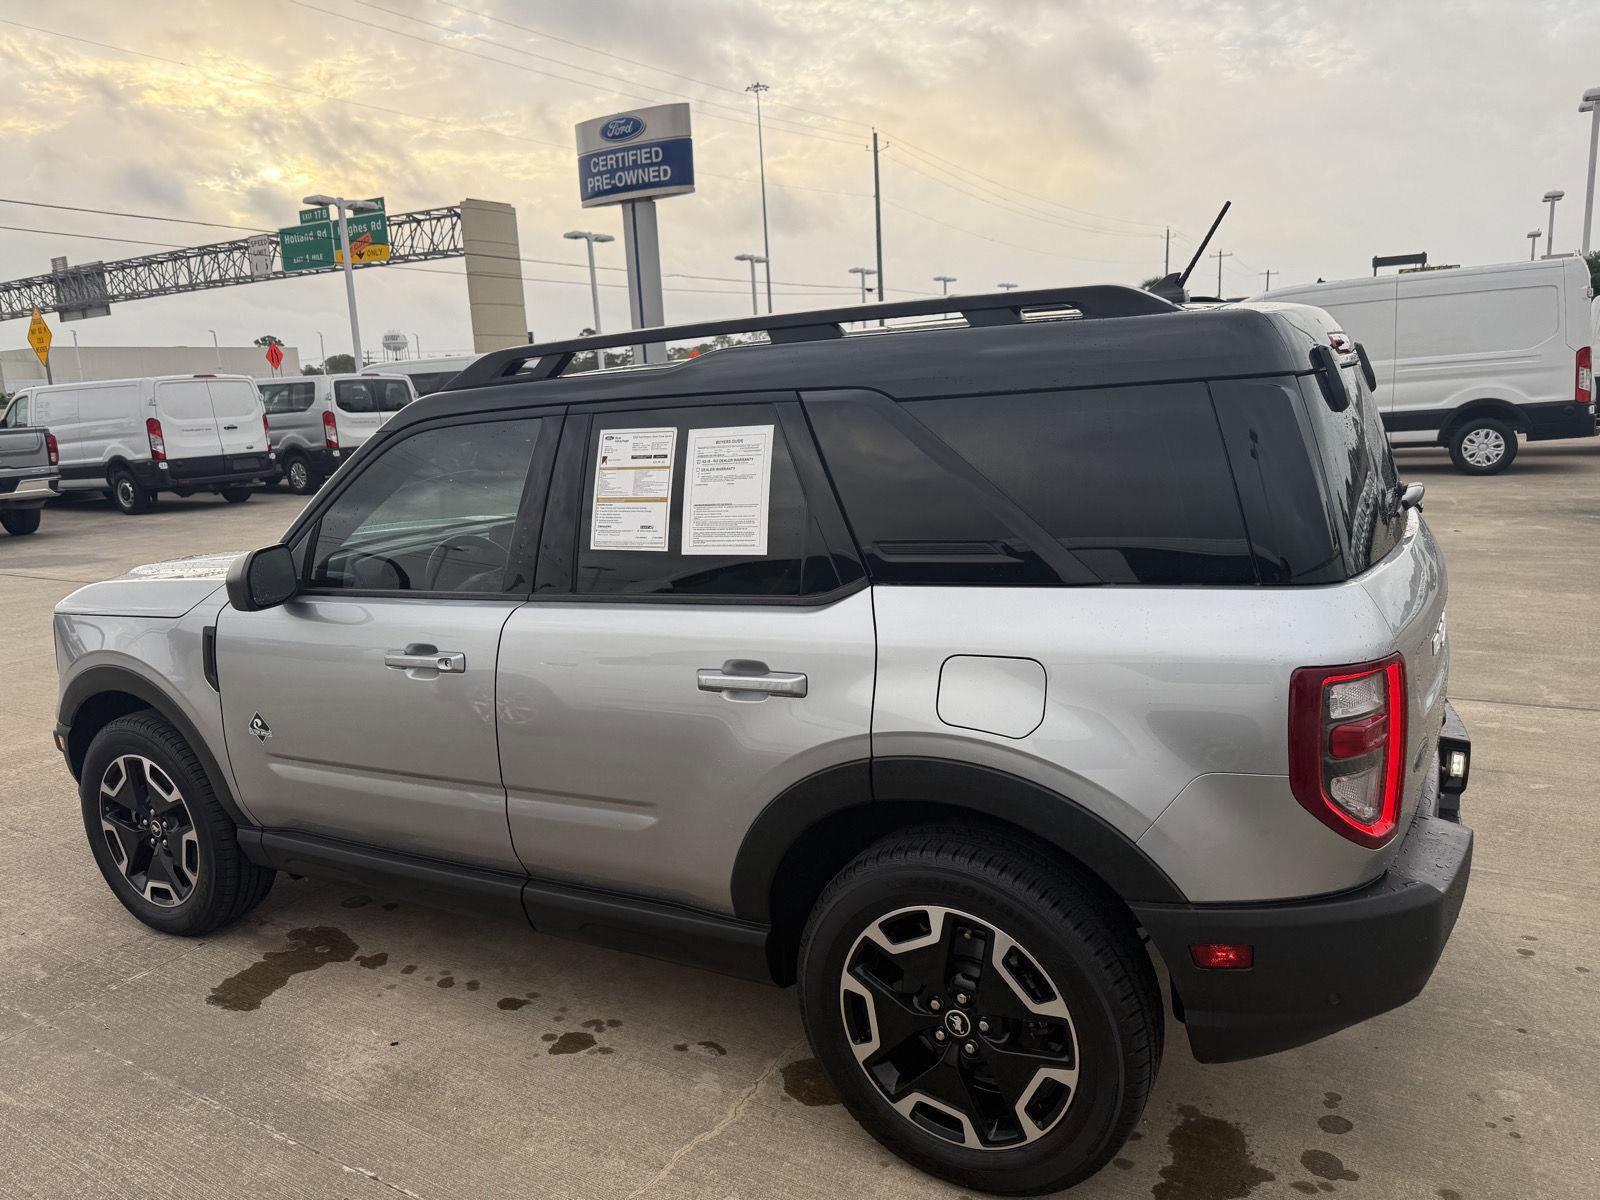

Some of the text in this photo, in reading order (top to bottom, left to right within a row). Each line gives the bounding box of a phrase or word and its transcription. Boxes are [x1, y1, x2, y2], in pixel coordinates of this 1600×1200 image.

[607, 118, 633, 137] Ford
[590, 147, 663, 173] CERTIFIED
[587, 165, 672, 193] PRE-OWNED
[314, 210, 321, 220] 17
[322, 209, 328, 219] B
[371, 219, 382, 231] Rd
[250, 238, 268, 247] SPEED
[284, 228, 328, 245] Holland Rd
[366, 248, 383, 258] ONLY
